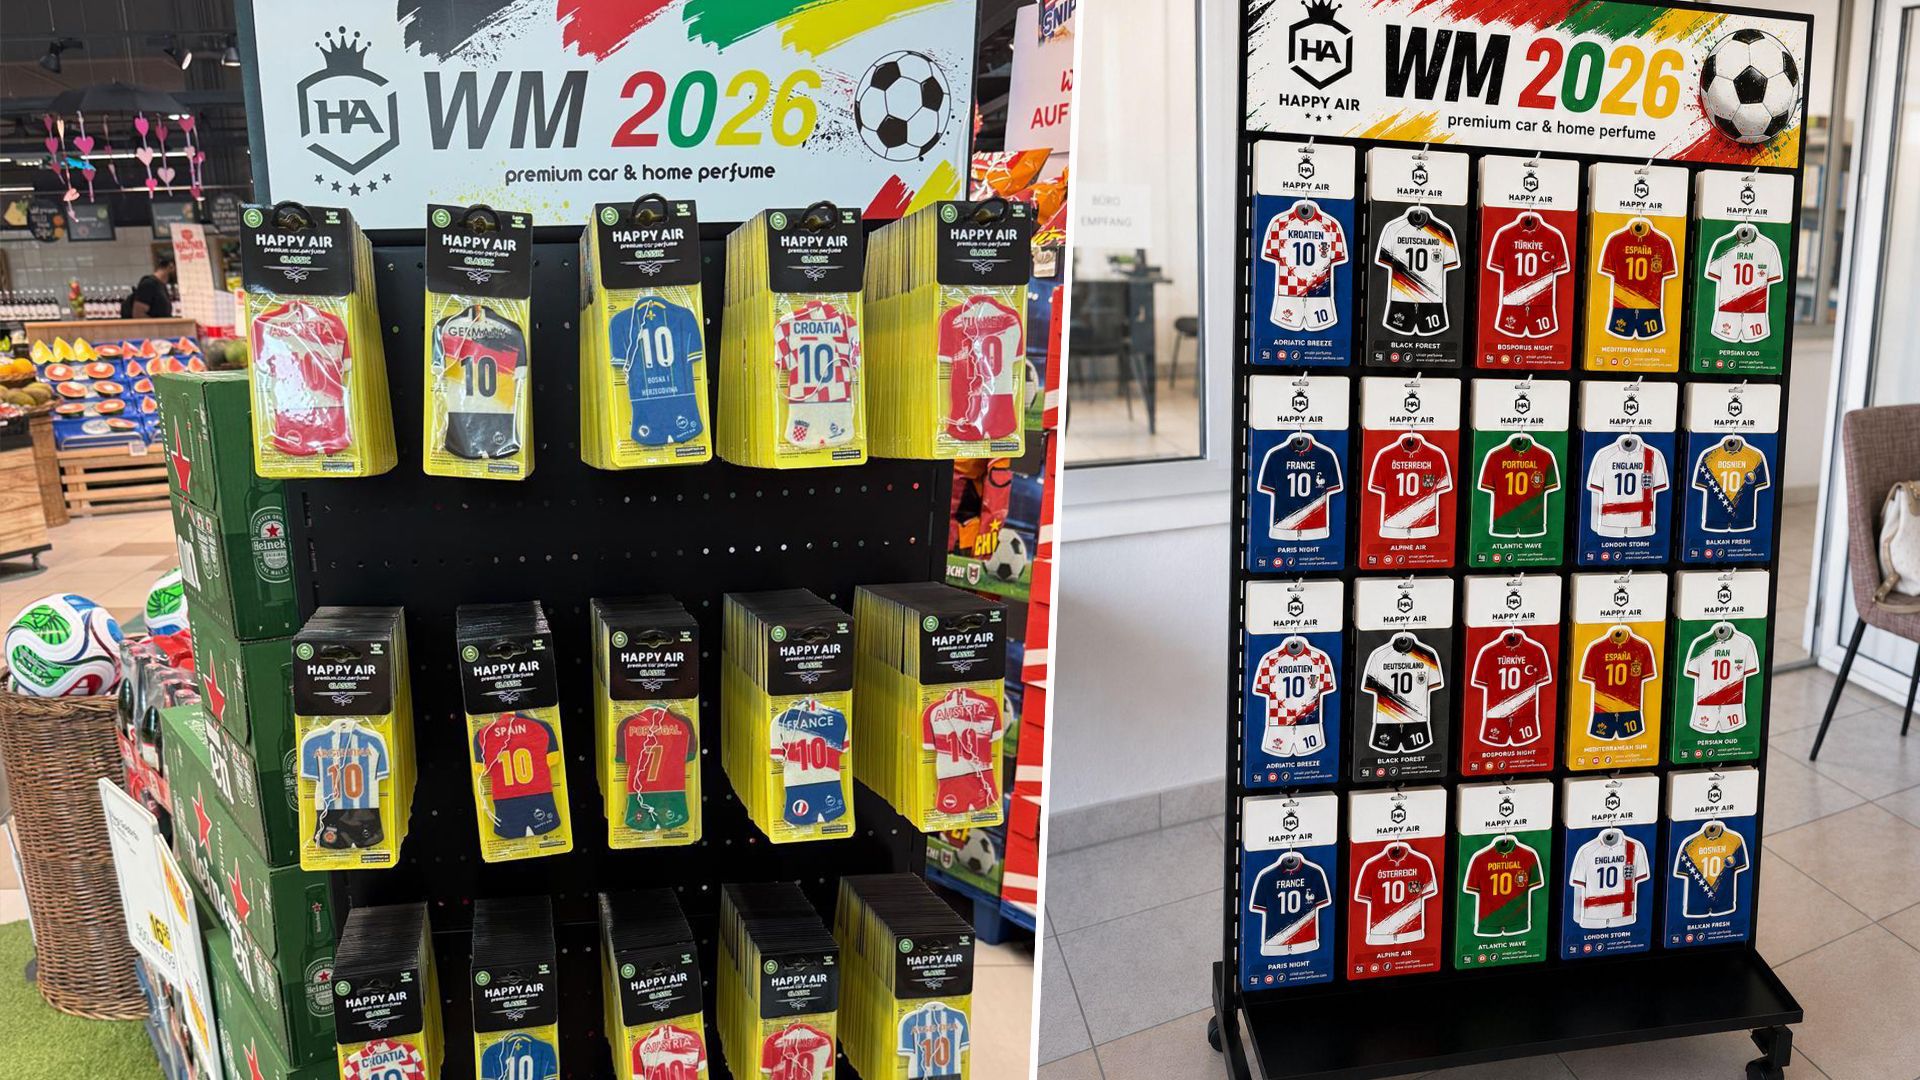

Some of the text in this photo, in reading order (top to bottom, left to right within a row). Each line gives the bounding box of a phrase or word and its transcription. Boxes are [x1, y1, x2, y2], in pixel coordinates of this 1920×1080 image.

[1385, 24, 1685, 120] WM 2026
[423, 69, 822, 150] WM 2026
[1279, 93, 1360, 112] HAPPY AIR
[1030, 102, 1070, 130] AUF
[1448, 114, 1657, 142] premium car & home perfume
[505, 163, 776, 186] premium car & home perfume
[1282, 180, 1330, 191] HAPPY AIR
[1397, 187, 1443, 197] HAPPY AIR
[1508, 193, 1553, 203] HAPPY AIR
[1619, 200, 1663, 210] HAPPY AIR
[1726, 207, 1768, 216] HAPPY AIR
[256, 233, 333, 249] HAPPY AIR
[442, 233, 517, 252] HAPPY AIR
[612, 228, 684, 243] HAPPY AIR
[781, 235, 848, 248] HAPPY AIR
[950, 229, 1018, 241] HAPPY AIR
[1288, 229, 1324, 240] KROATIEN
[1292, 241, 1315, 266] 10
[1405, 247, 1428, 271] 10
[1736, 252, 1754, 261] IRAN
[1514, 252, 1537, 277] 10
[1625, 256, 1648, 280] 10
[1733, 263, 1754, 286] 10
[793, 321, 842, 335] CROATIA
[640, 326, 675, 369] 10
[798, 343, 835, 384] 10
[461, 355, 498, 398] 10
[1286, 461, 1316, 470] FRANCE
[1391, 459, 1432, 470] ÖSTERREICH
[1501, 460, 1538, 470] PORTUGAL
[1287, 472, 1312, 497] 10
[1396, 472, 1420, 497] 10
[1504, 471, 1528, 496] 10
[1614, 473, 1637, 496] 10
[1720, 471, 1741, 493] 10
[932, 632, 994, 646] HAPPY AIR
[621, 652, 684, 662] HAPPY AIR
[780, 643, 841, 657] HAPPY AIR
[1714, 649, 1731, 658] IRAN
[307, 664, 376, 675] HAPPY AIR
[473, 660, 540, 676] HAPPY AIR
[1278, 664, 1313, 674] KROATIEN
[494, 724, 527, 737] SPAIN
[786, 715, 834, 730] FRANCE
[795, 737, 829, 771] 10
[946, 728, 978, 763] 10
[498, 747, 534, 787] 10
[644, 745, 664, 782] 7
[1487, 861, 1521, 871] PORTUGAL
[1594, 856, 1624, 865] ENGLAND
[1701, 856, 1721, 878] 10
[1377, 868, 1417, 879] ÖSTERREICH
[1597, 866, 1618, 889] 10
[1276, 877, 1305, 889] FRANCE
[1489, 872, 1512, 896] 10
[906, 953, 963, 966] HAPPY AIR
[630, 972, 688, 991] HAPPY AIR
[771, 974, 827, 987] HAPPY AIR
[484, 983, 544, 998] HAPPY AIR
[345, 991, 408, 1009] HAPPY AIR
[361, 1050, 406, 1068] CROATIA
[921, 1036, 951, 1068] 10
